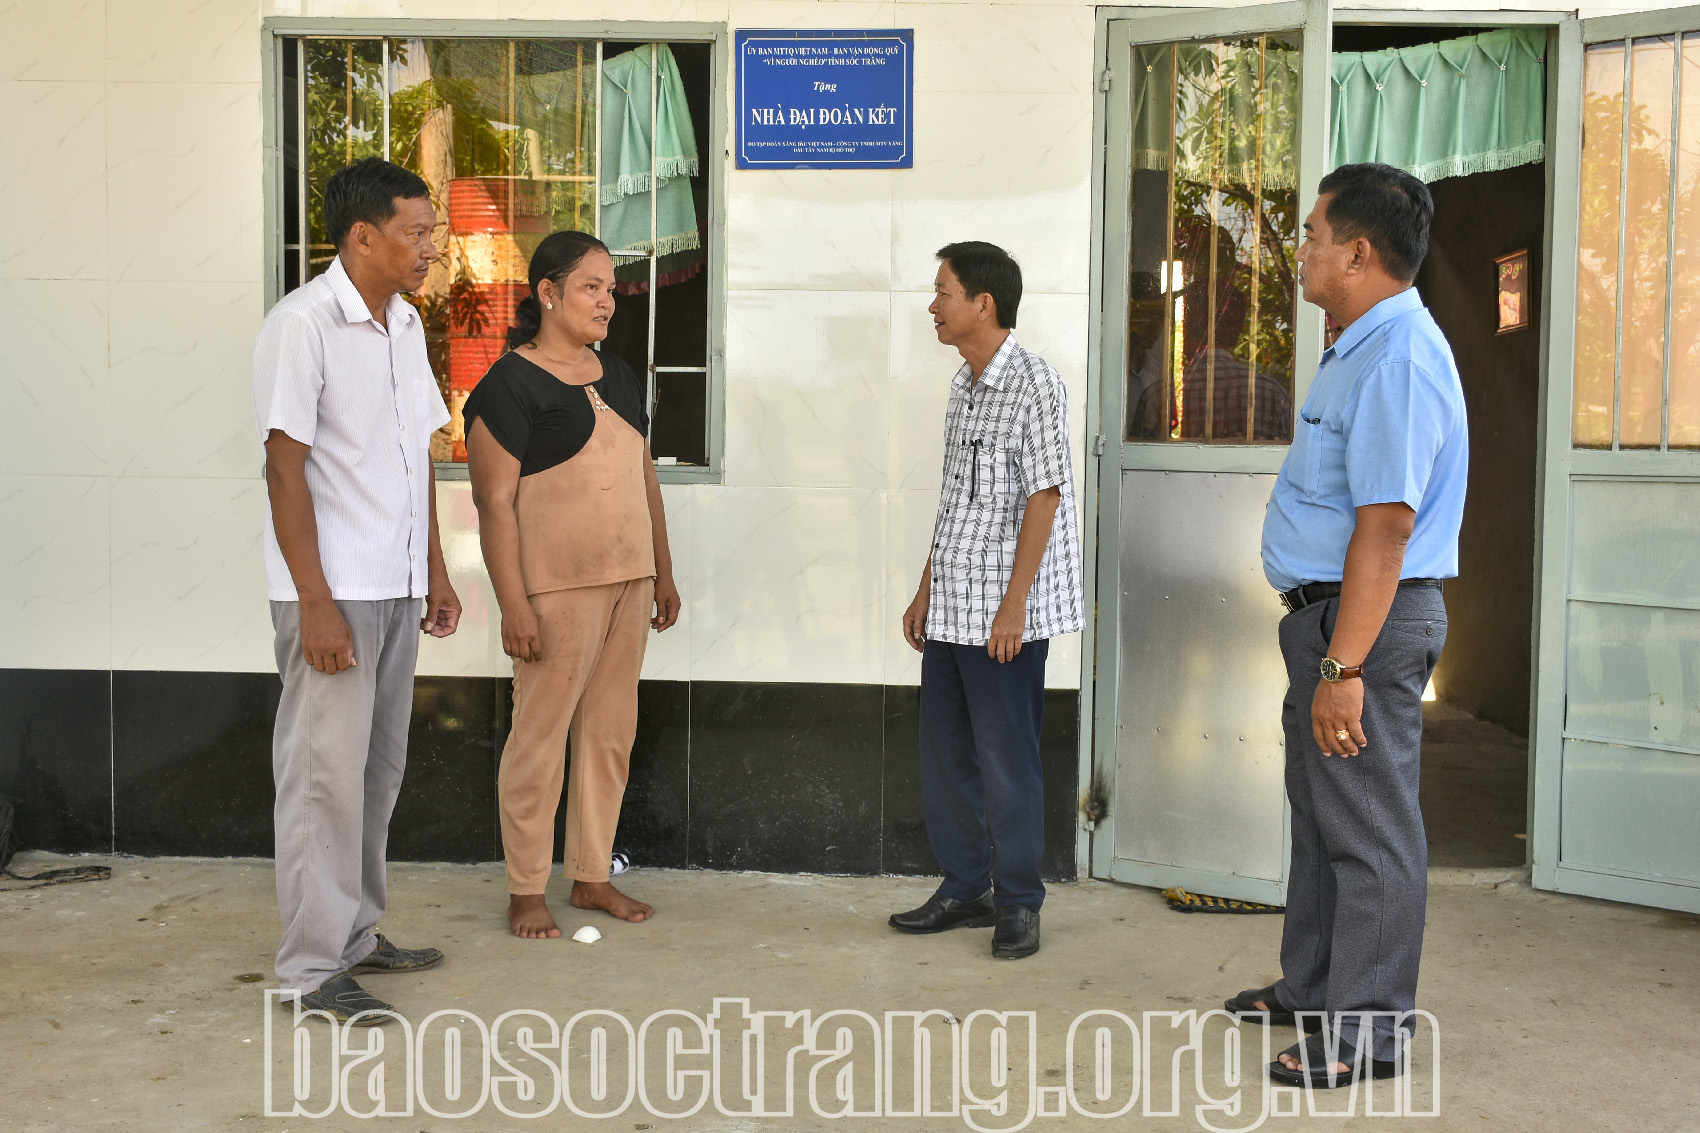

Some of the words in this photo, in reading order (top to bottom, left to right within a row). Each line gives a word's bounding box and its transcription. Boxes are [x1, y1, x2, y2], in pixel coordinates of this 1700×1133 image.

[758, 47, 773, 55] BAN
[773, 47, 794, 56] MTTQ
[794, 46, 810, 56] VIỆT
[812, 47, 828, 55] NAM
[834, 47, 848, 55] BAN
[849, 46, 862, 56] VẬN
[864, 46, 884, 56] ĐỘNG
[776, 56, 798, 66] NGƯỜI
[846, 56, 860, 66] SÓC
[861, 56, 886, 66] TRĂNG
[813, 81, 838, 93] Tặng
[751, 103, 786, 126] NHÀ
[789, 108, 816, 130] ĐẠI
[818, 103, 864, 126] ĐOÀN
[868, 102, 898, 125] KẾT
